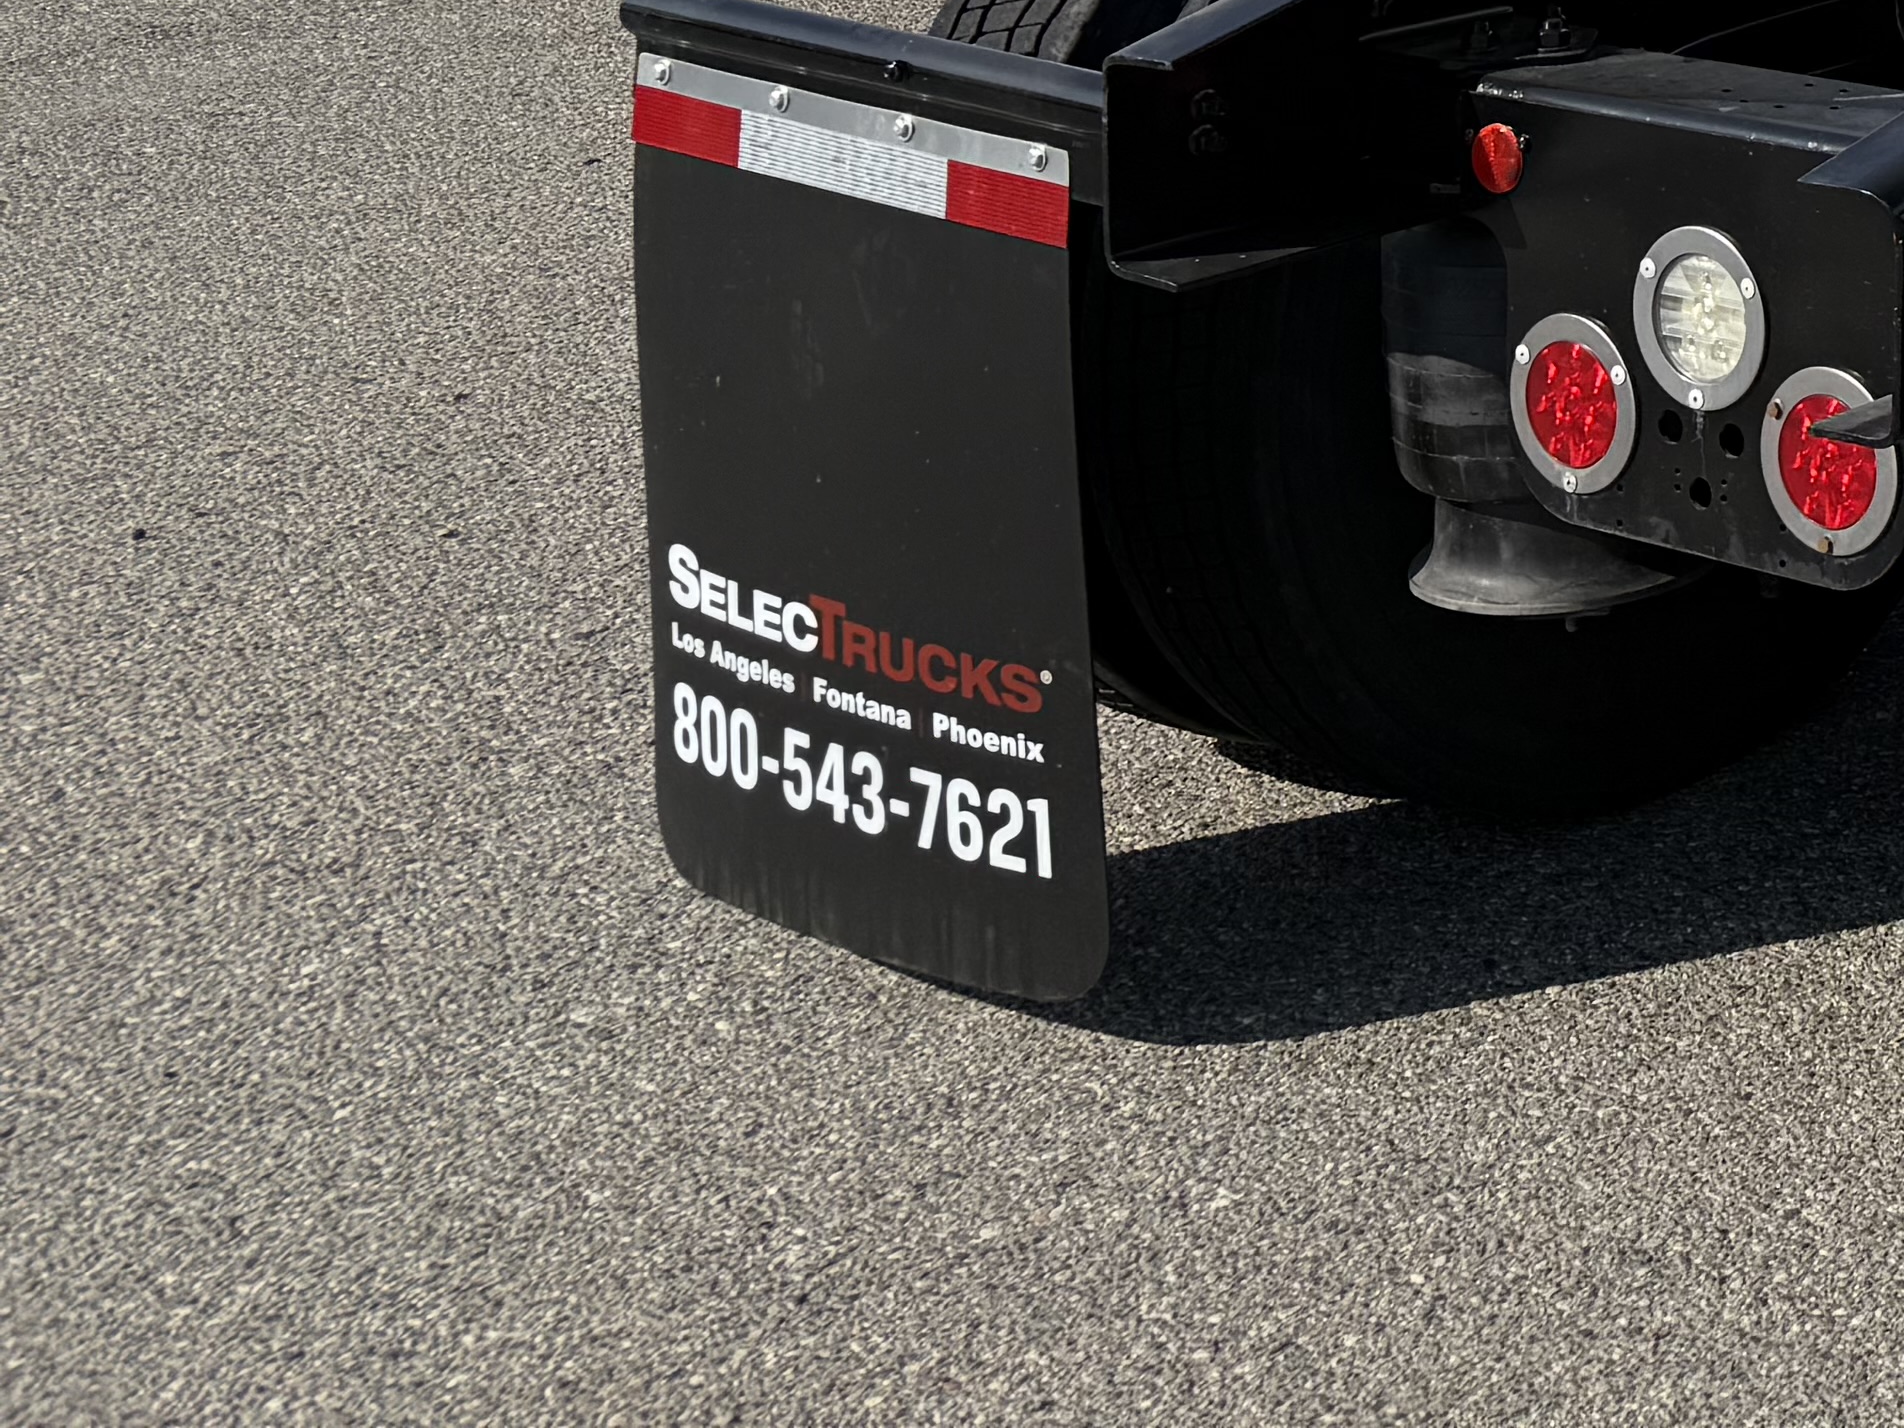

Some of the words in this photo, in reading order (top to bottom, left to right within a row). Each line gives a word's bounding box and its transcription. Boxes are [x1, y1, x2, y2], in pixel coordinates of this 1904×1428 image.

[671, 621, 706, 659] Los
[709, 639, 796, 694] Angeles
[812, 676, 912, 731] Fontana
[932, 711, 1045, 764] Phoenix
[673, 681, 1053, 879] 800-543-7621
